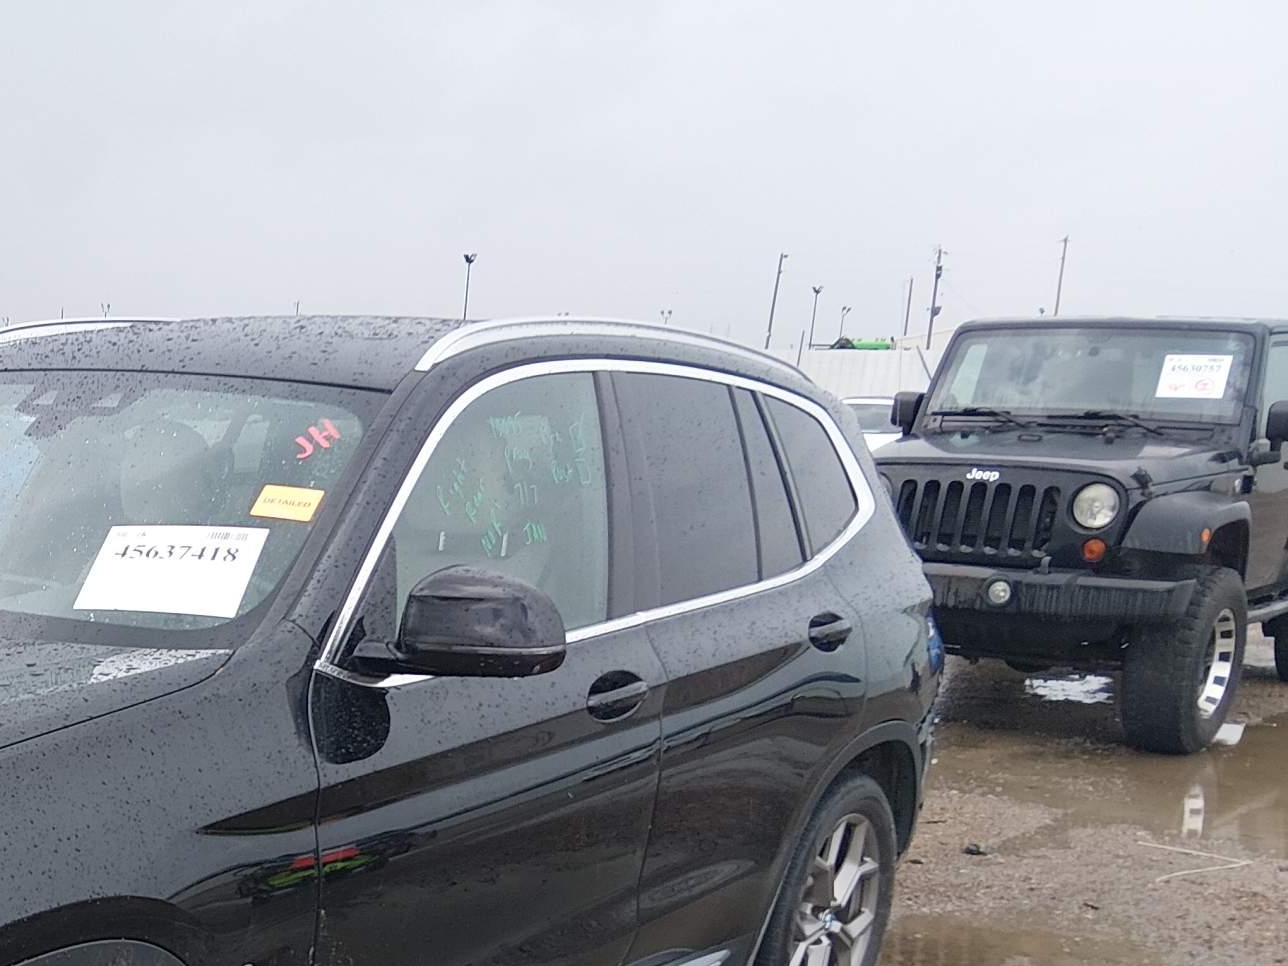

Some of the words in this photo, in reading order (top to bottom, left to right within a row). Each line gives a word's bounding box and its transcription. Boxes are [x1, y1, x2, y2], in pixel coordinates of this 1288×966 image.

[295, 418, 341, 459] JH
[966, 467, 1000, 482] Jeep
[263, 497, 312, 508] DETAILED
[114, 544, 239, 562] 45637418
